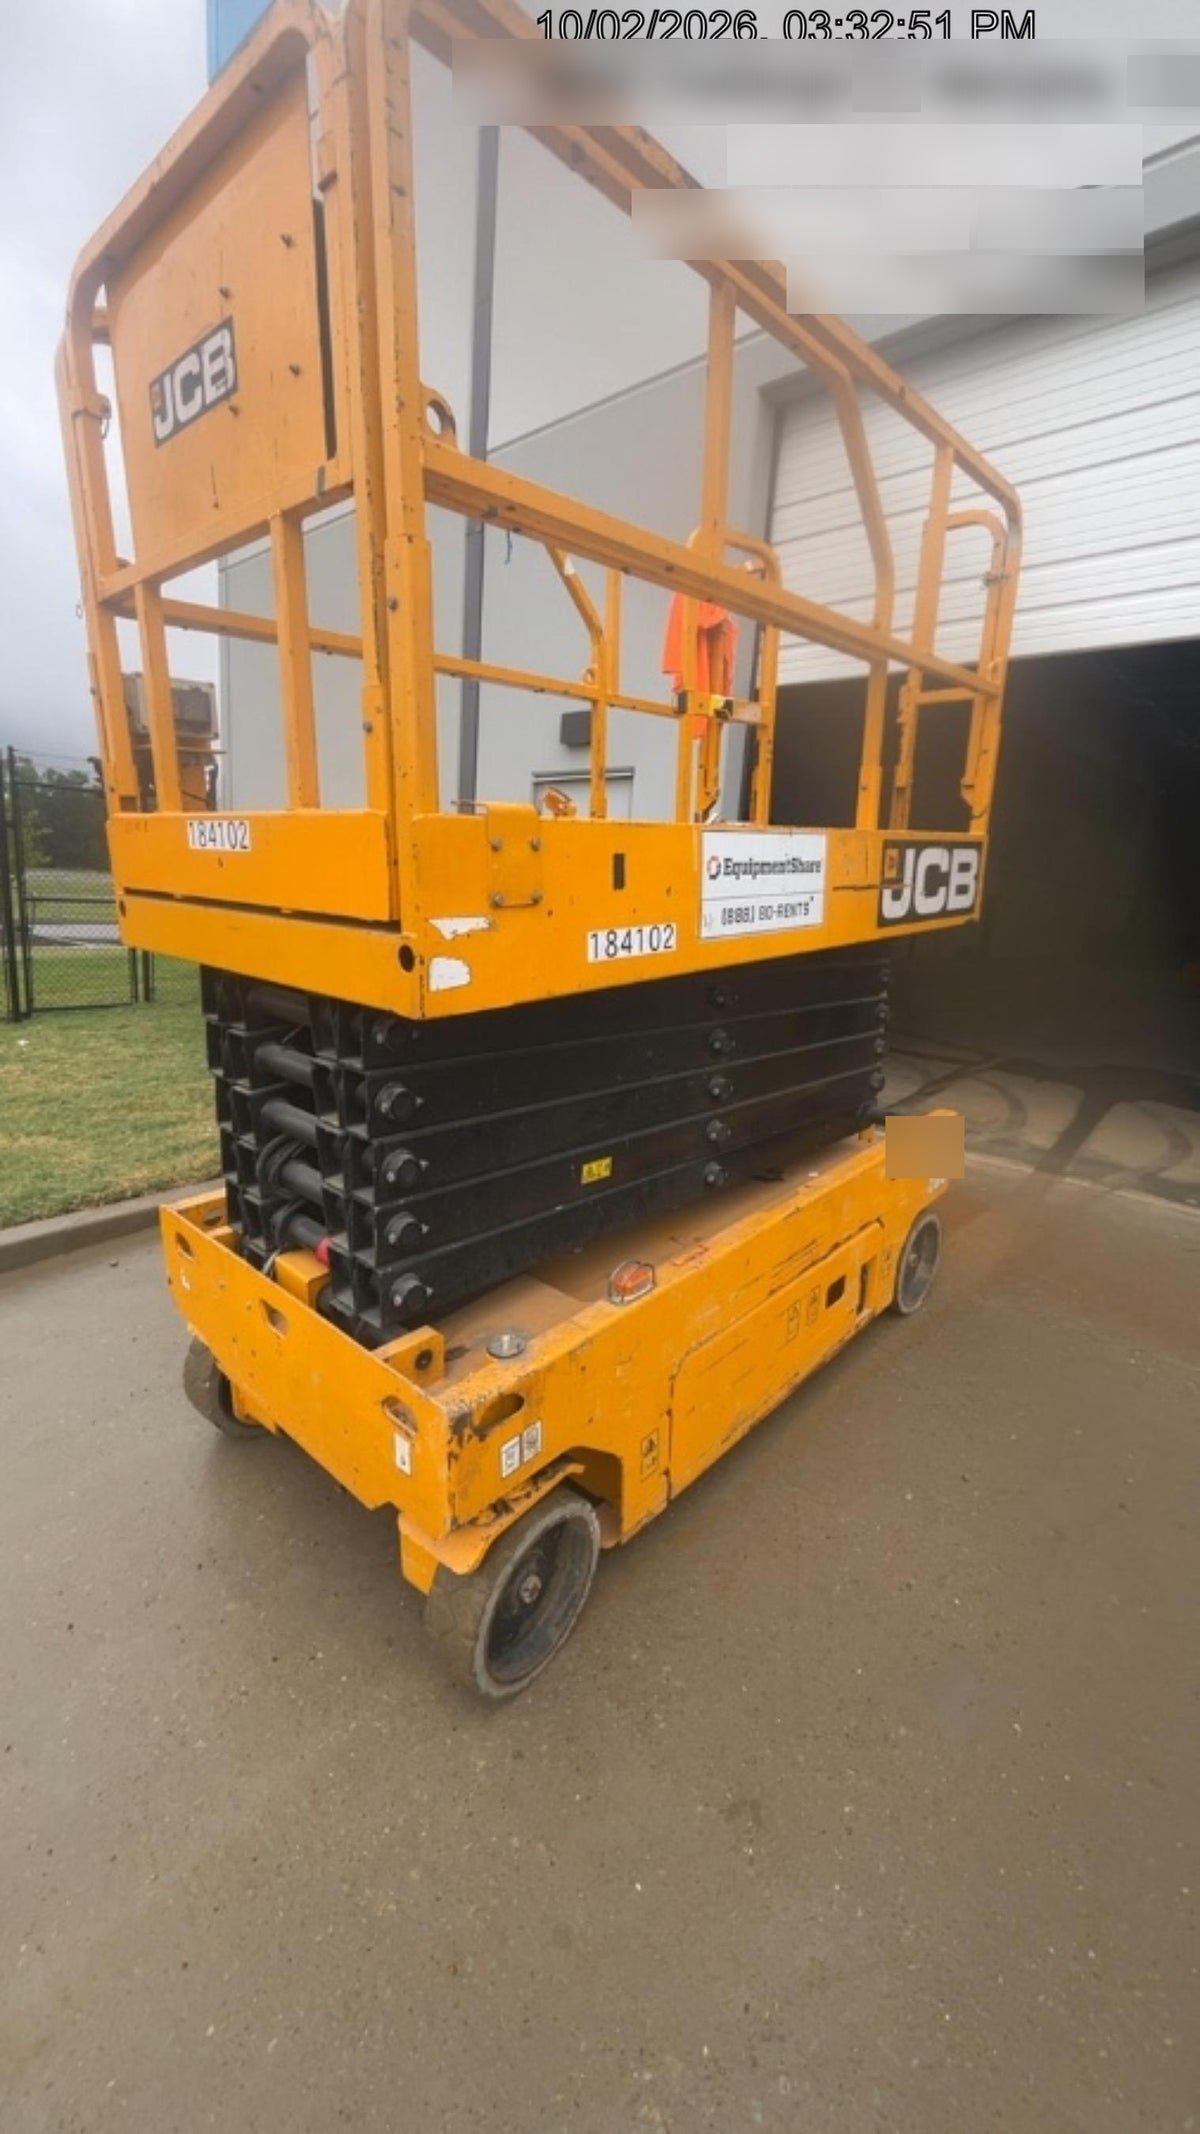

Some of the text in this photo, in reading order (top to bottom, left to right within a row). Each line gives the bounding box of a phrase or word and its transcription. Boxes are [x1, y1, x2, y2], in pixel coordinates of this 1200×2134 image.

[154, 328, 235, 440] JCB
[189, 821, 248, 849] 184102
[723, 857, 821, 880] EquipmentShare
[882, 847, 978, 919] JCB
[591, 924, 674, 959] 184102
